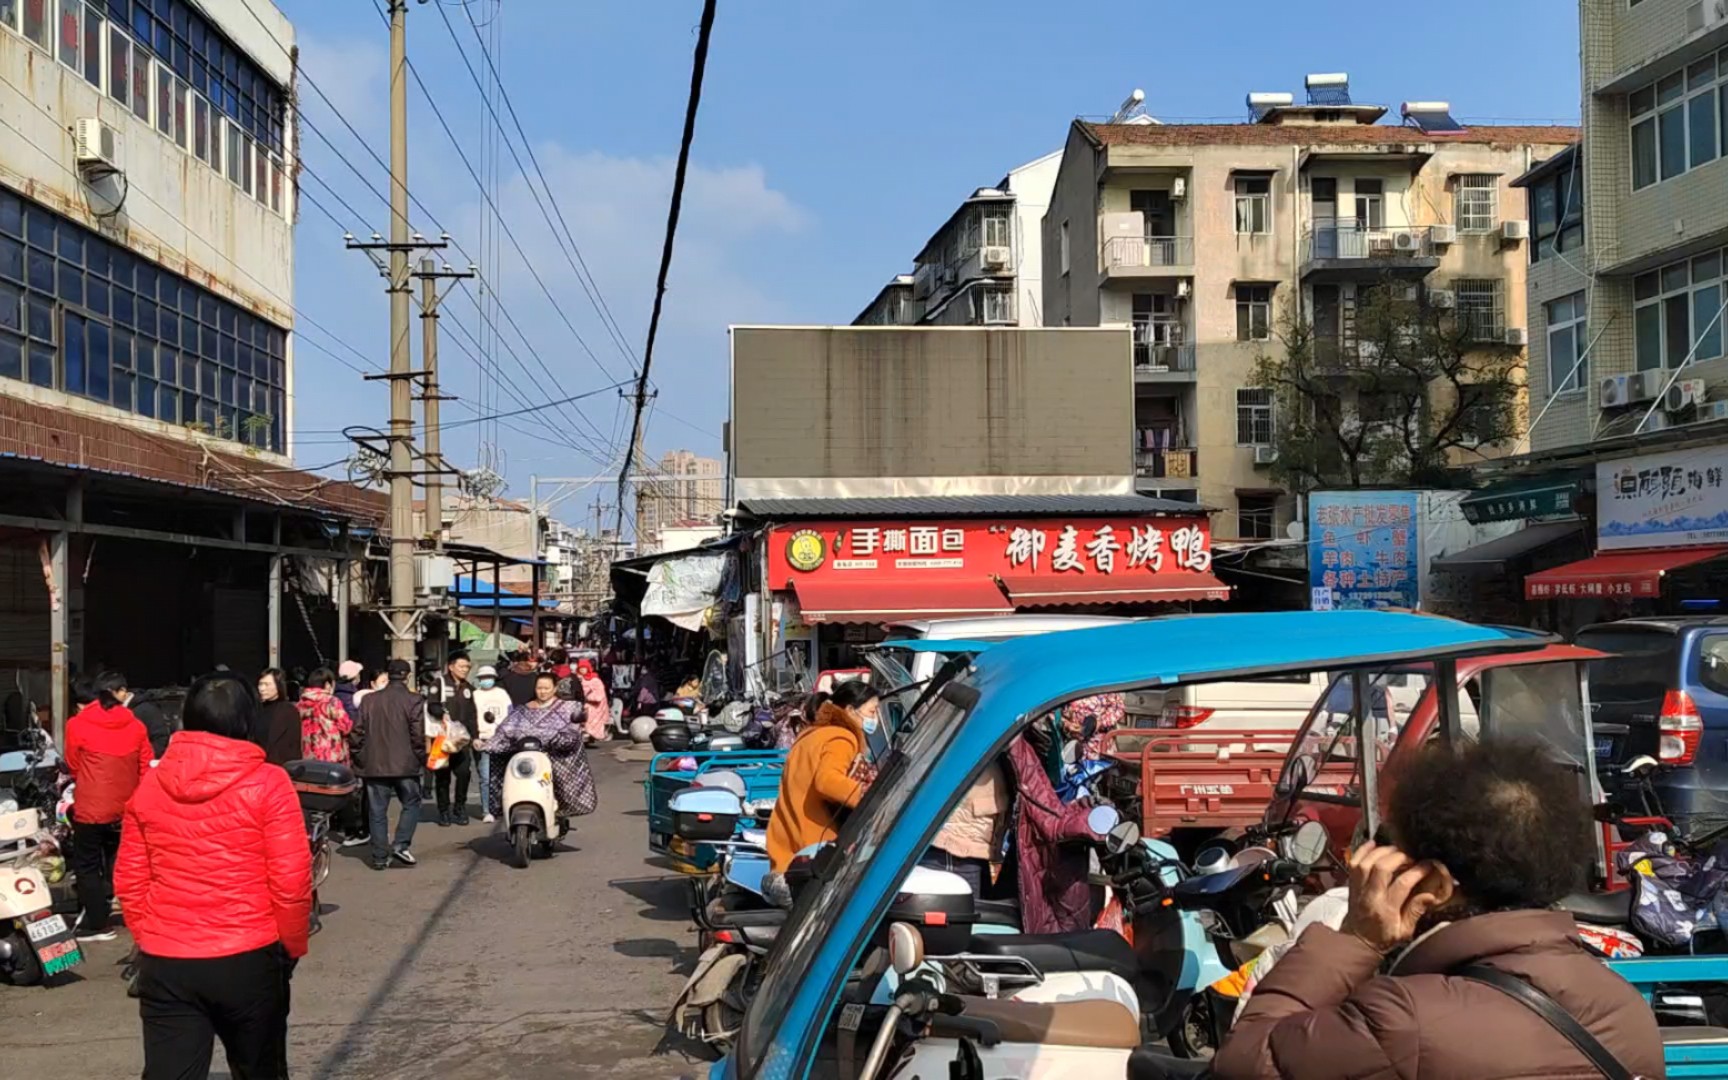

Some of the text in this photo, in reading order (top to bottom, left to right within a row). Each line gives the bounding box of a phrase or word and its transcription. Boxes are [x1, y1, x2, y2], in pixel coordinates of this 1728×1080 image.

[851, 526, 964, 555] 手撕面包
[1322, 568, 1408, 589] 各种土特产
